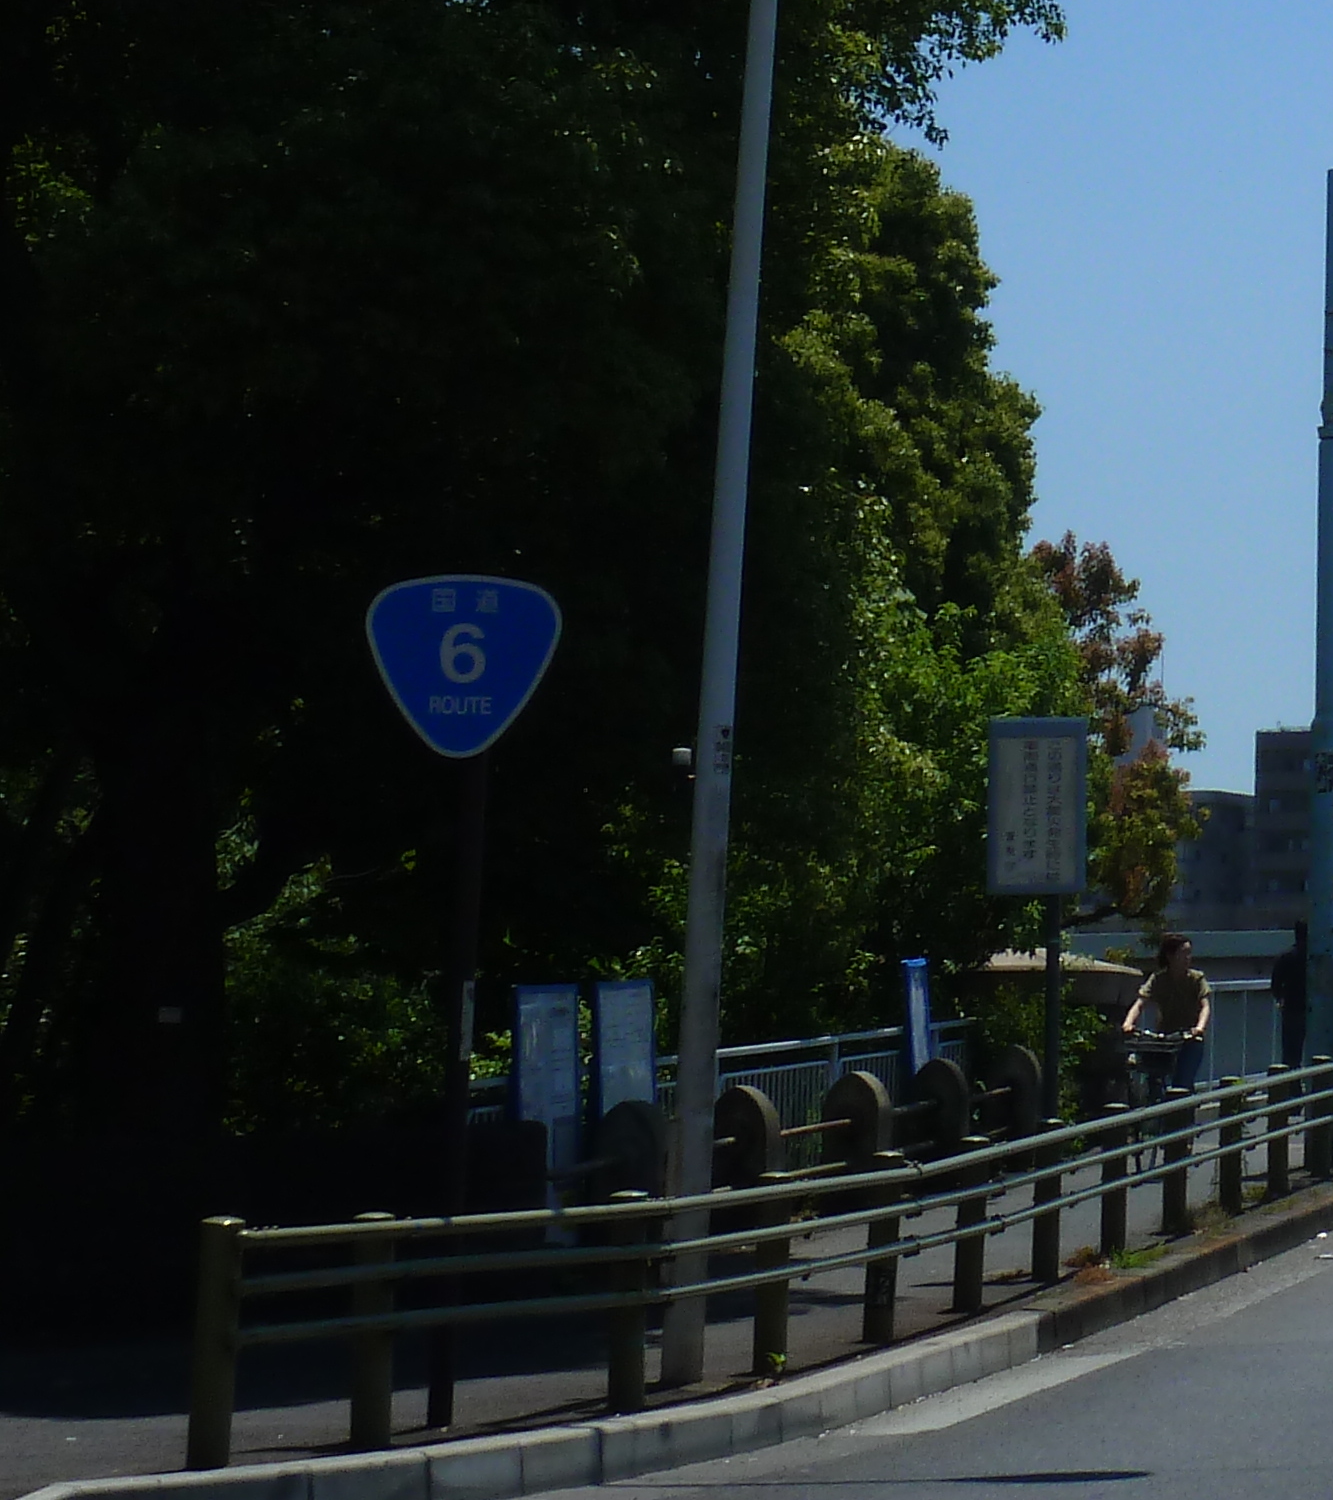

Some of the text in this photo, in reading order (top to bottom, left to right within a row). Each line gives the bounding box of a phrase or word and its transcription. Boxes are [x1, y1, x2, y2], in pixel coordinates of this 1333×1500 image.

[431, 587, 499, 613] 国道
[439, 622, 487, 684] 6
[428, 696, 493, 715] ROUTE
